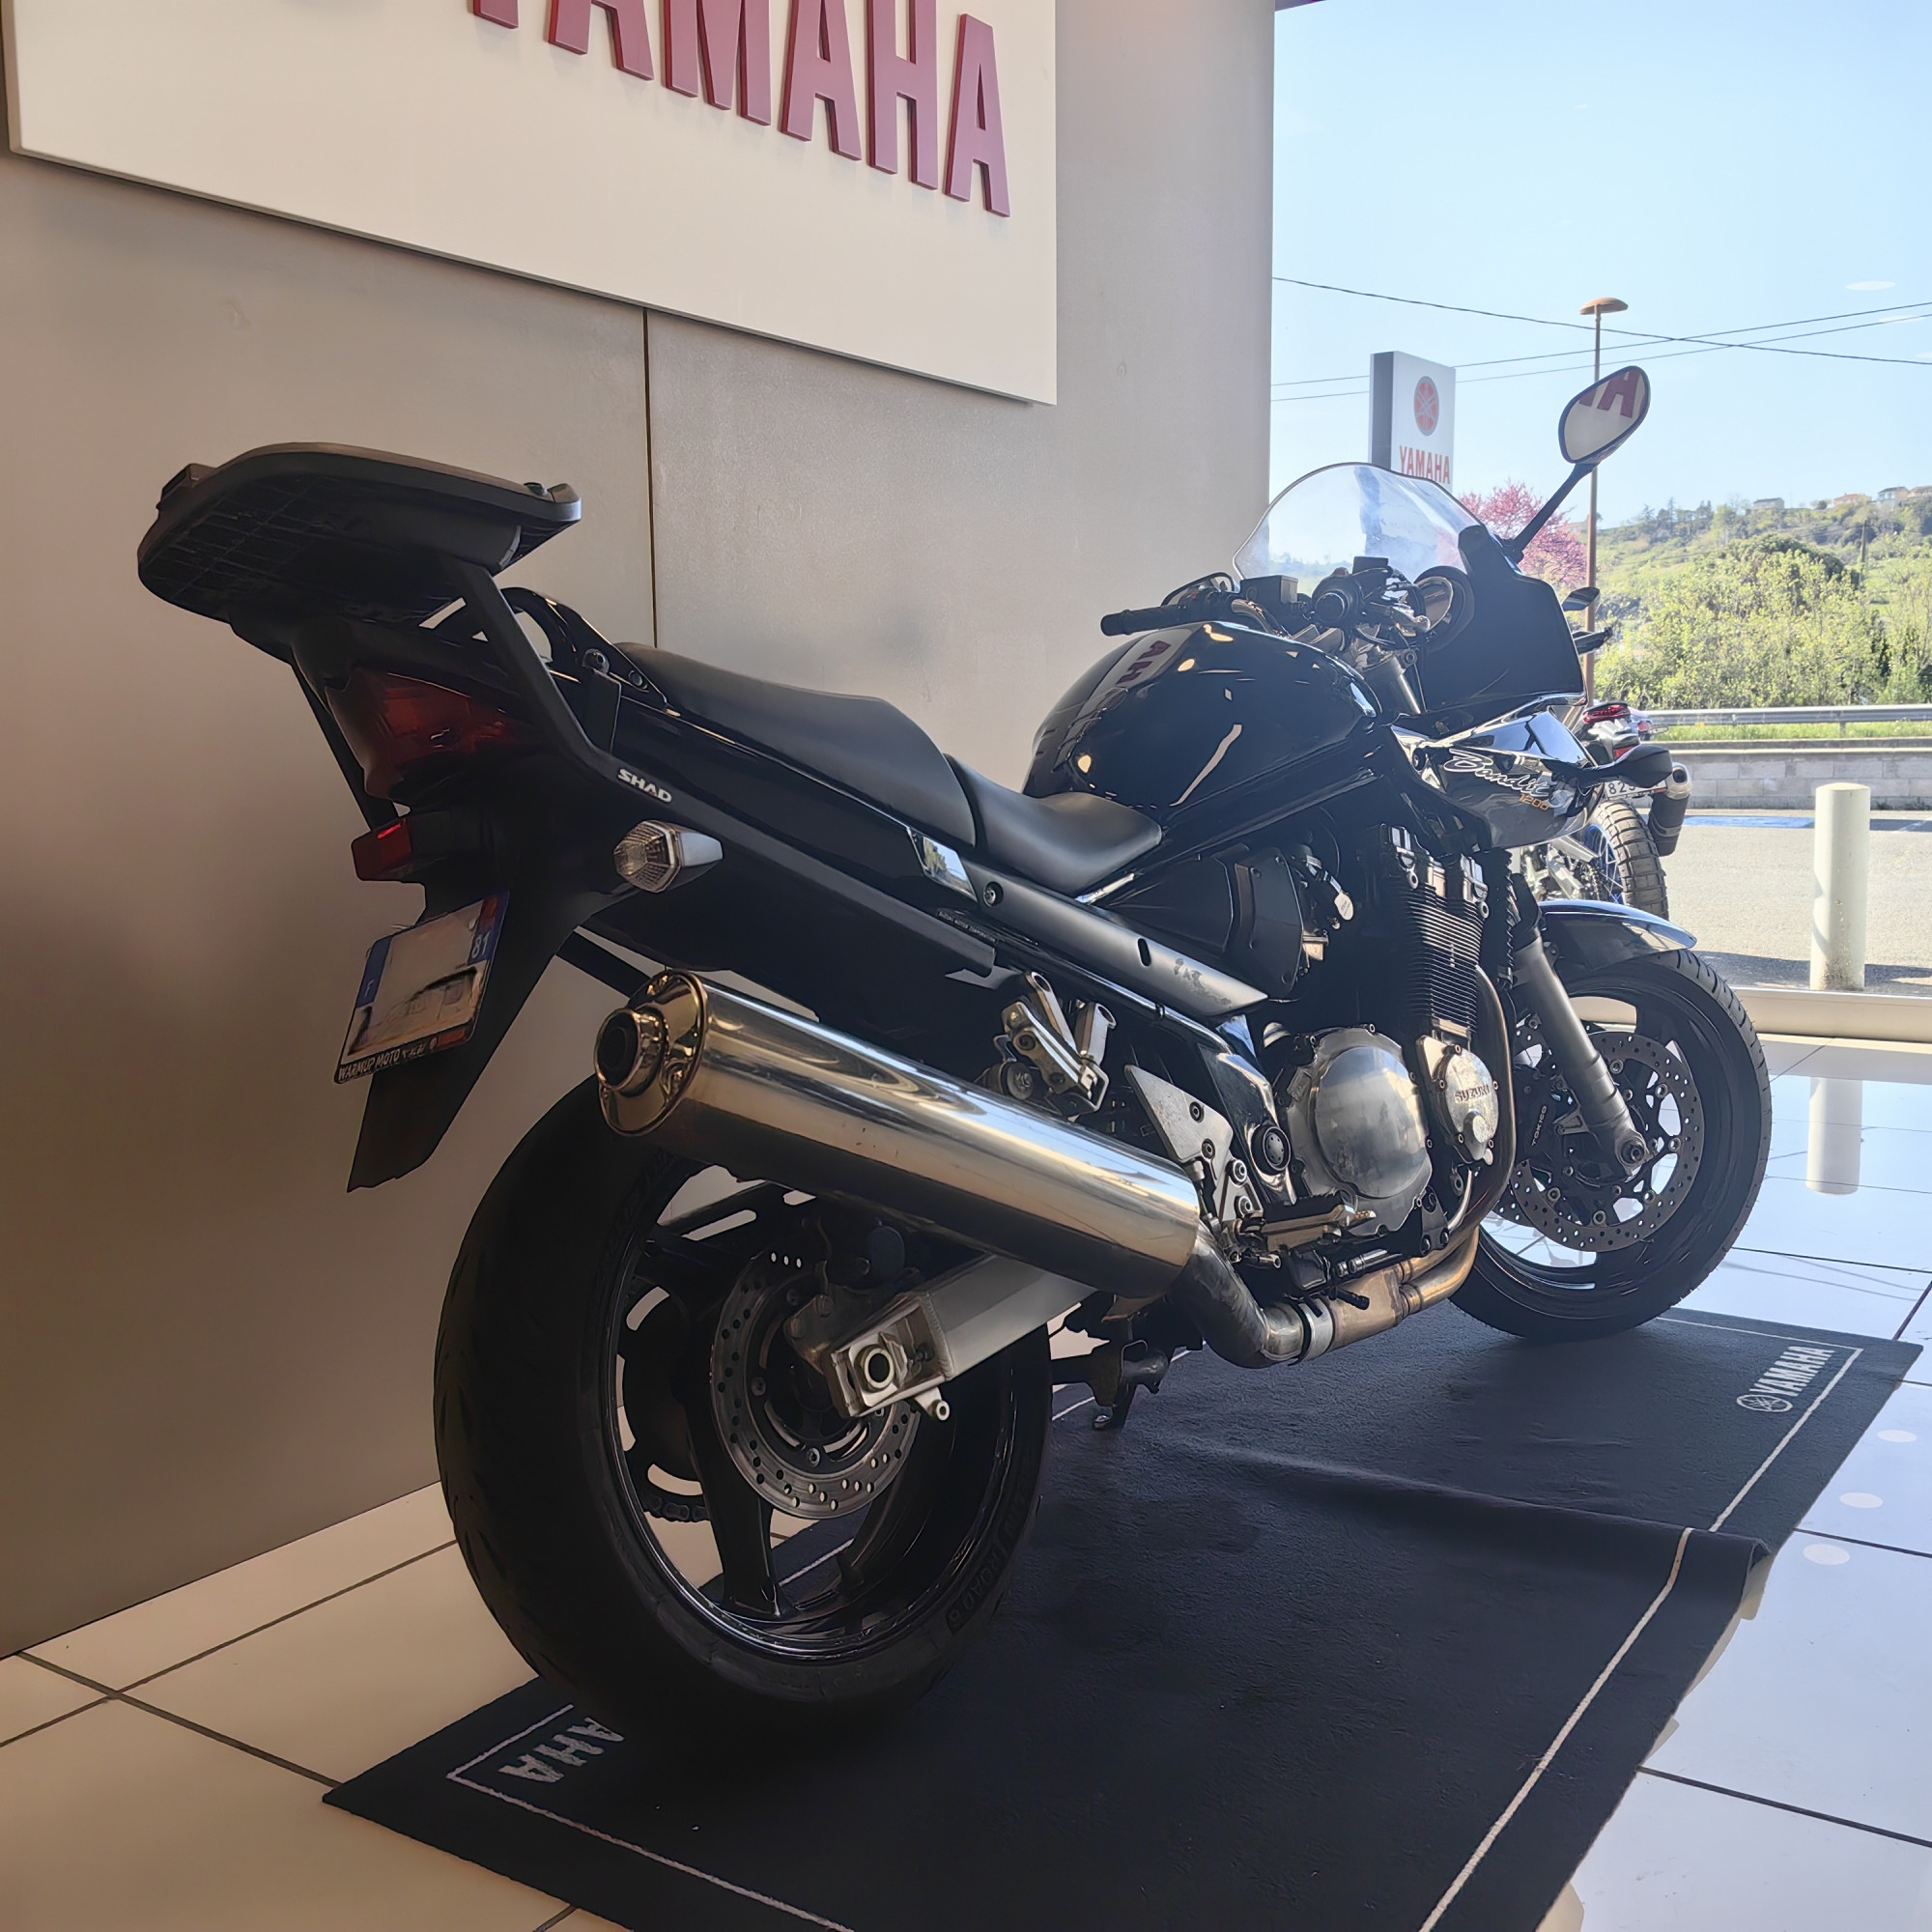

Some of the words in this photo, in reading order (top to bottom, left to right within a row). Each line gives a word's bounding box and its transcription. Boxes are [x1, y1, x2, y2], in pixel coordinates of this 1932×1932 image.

[472, 0, 1010, 217] MAHA
[1399, 445, 1451, 484] YAMAHA
[618, 768, 672, 803] SHAD
[1443, 748, 1549, 797] Bandit
[1519, 793, 1549, 810] 1200
[471, 930, 493, 959] 81
[338, 1057, 376, 1082] WARMUP
[375, 1048, 401, 1069] MOTO
[1454, 1084, 1491, 1103] SUZUKI
[1531, 1104, 1548, 1147] TOKICO
[1748, 1346, 1835, 1397] YAMAHA
[497, 1717, 626, 1783] AHA
